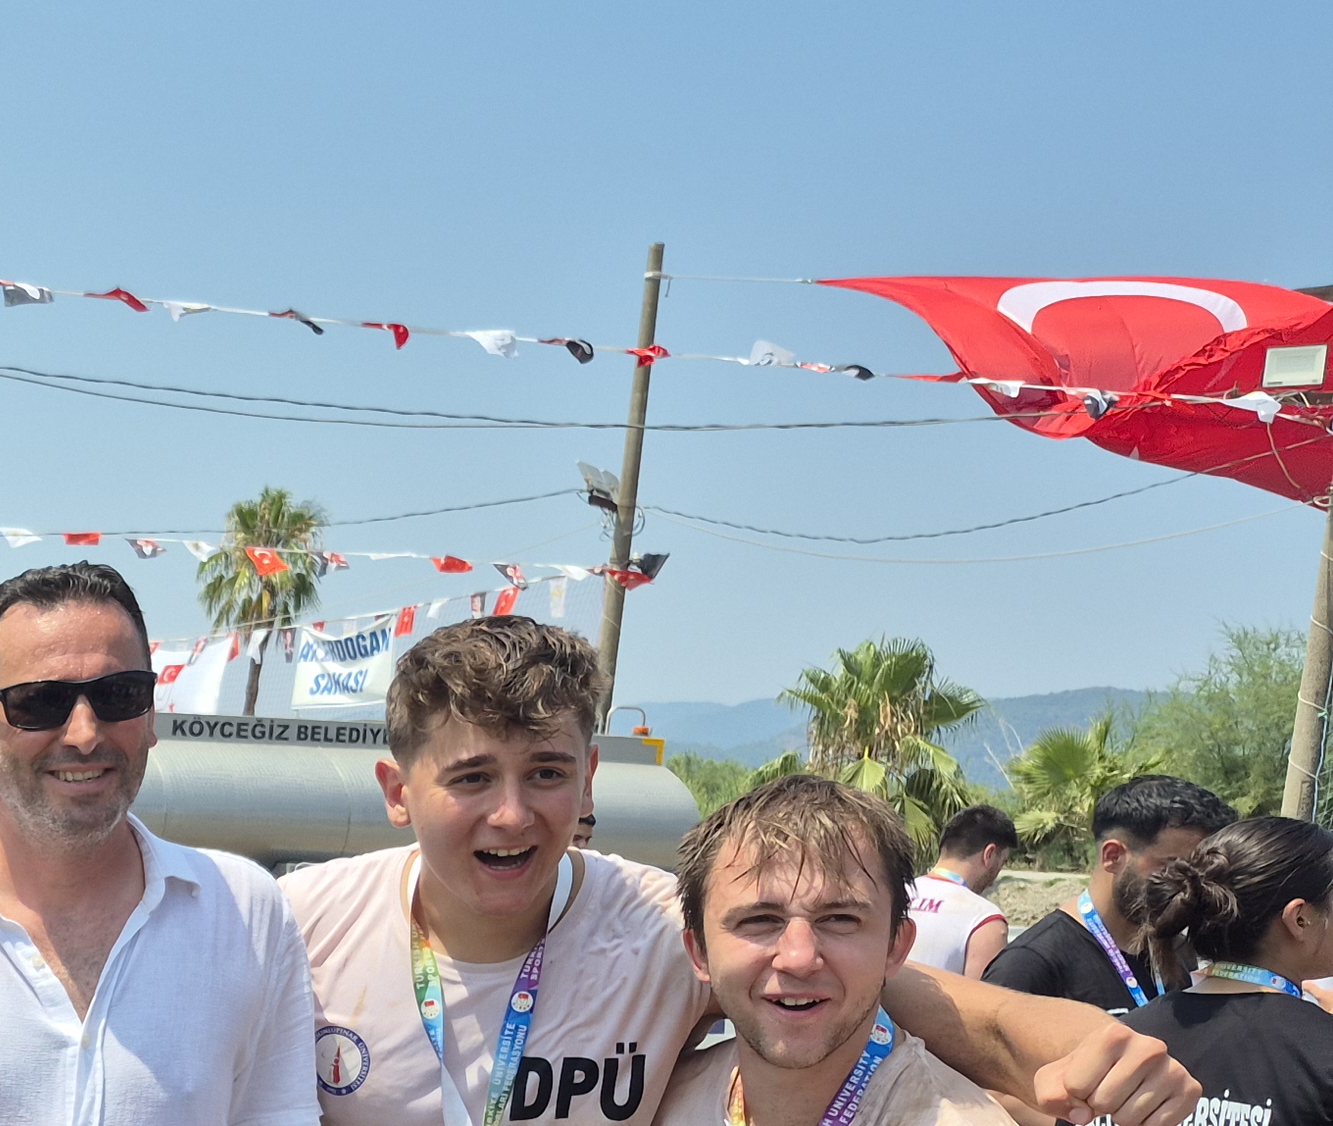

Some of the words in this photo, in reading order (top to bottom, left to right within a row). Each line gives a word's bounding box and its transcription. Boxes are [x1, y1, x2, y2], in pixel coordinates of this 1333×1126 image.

[172, 716, 289, 742] KÖYCEĞİZ
[493, 1021, 516, 1086] ÜNİVERSİTE
[509, 1042, 646, 1121] DPÜ
[828, 1050, 871, 1117] UNIVERSITY
